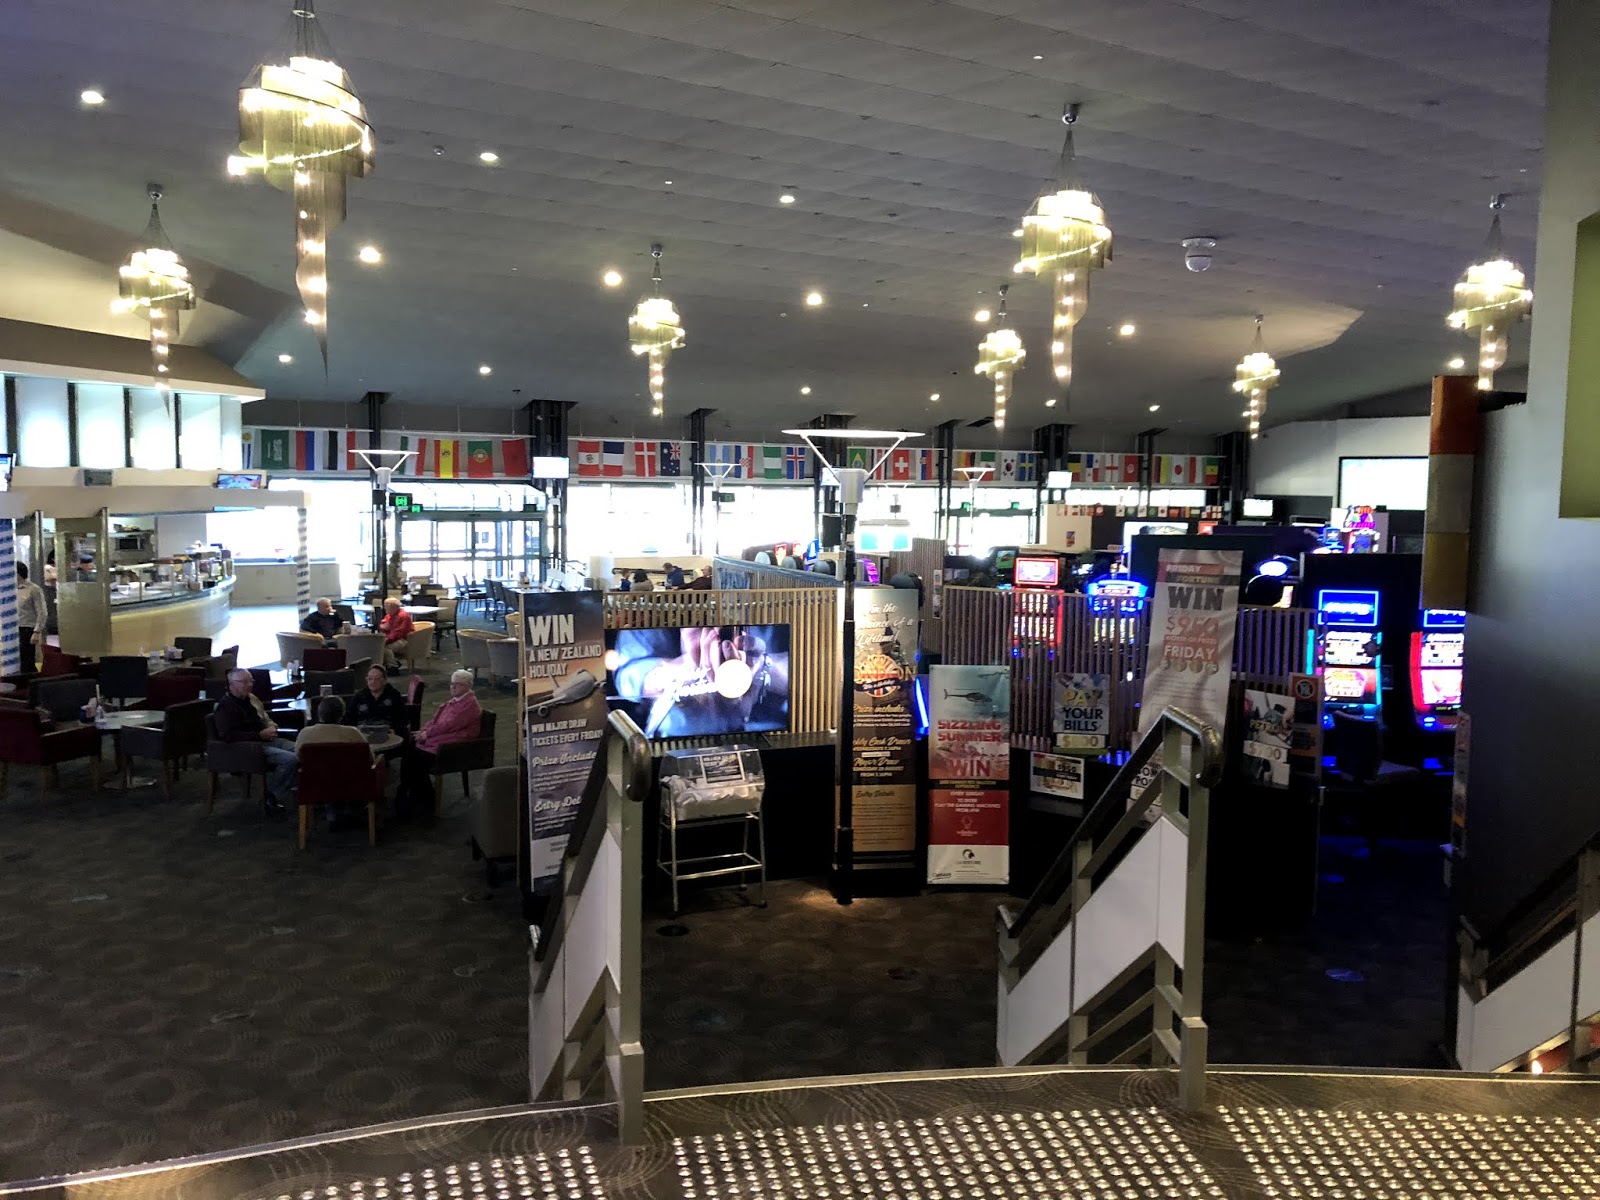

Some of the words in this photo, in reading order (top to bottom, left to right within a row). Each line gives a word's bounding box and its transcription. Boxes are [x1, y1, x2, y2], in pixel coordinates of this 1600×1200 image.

[1166, 564, 1201, 573] FRIDAY
[1168, 586, 1224, 611] WIN
[528, 614, 575, 646] WIN
[529, 649, 536, 662] A
[537, 648, 559, 662] NEW
[561, 644, 602, 660] ZEALAND
[1163, 645, 1216, 660] FRIDAY
[529, 663, 568, 678] HOLIDAY
[1062, 707, 1103, 720] YOUR
[937, 719, 1002, 730] SIZZLING
[1064, 720, 1098, 732] BILLS
[532, 735, 559, 746] TICKETS
[937, 731, 1002, 742] SUMMER
[532, 756, 558, 768] Prize
[948, 759, 991, 776] WIN
[534, 799, 560, 812] Entry
